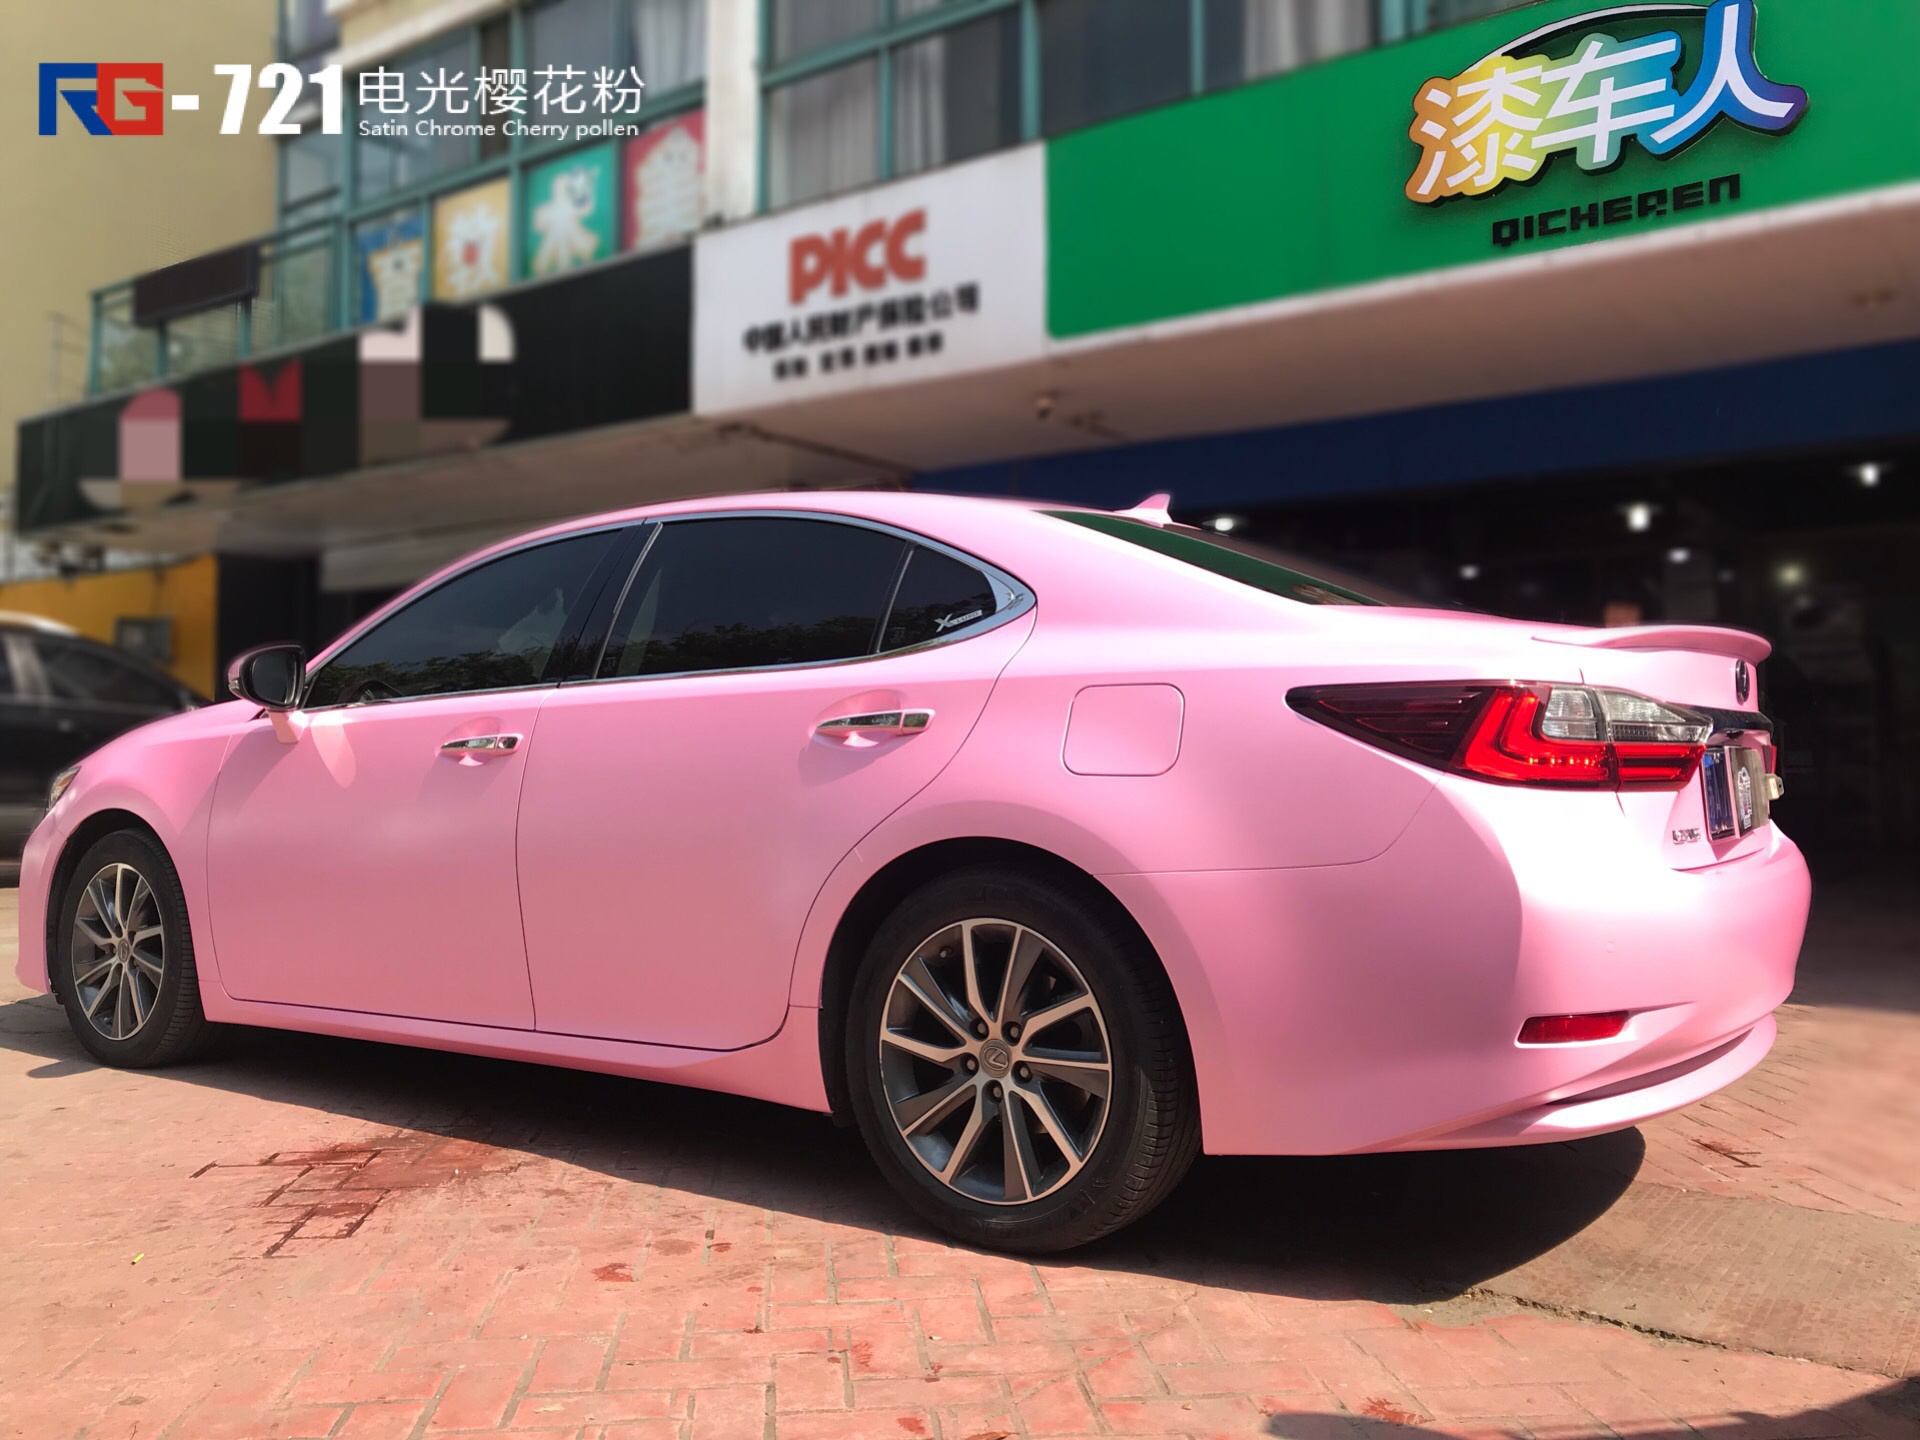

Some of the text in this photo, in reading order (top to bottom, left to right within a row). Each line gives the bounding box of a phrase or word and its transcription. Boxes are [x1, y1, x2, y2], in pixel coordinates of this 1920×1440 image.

[1415, 3, 1796, 195] 漆车人
[789, 208, 926, 304] PICC
[1492, 174, 1741, 247] QICHEREN
